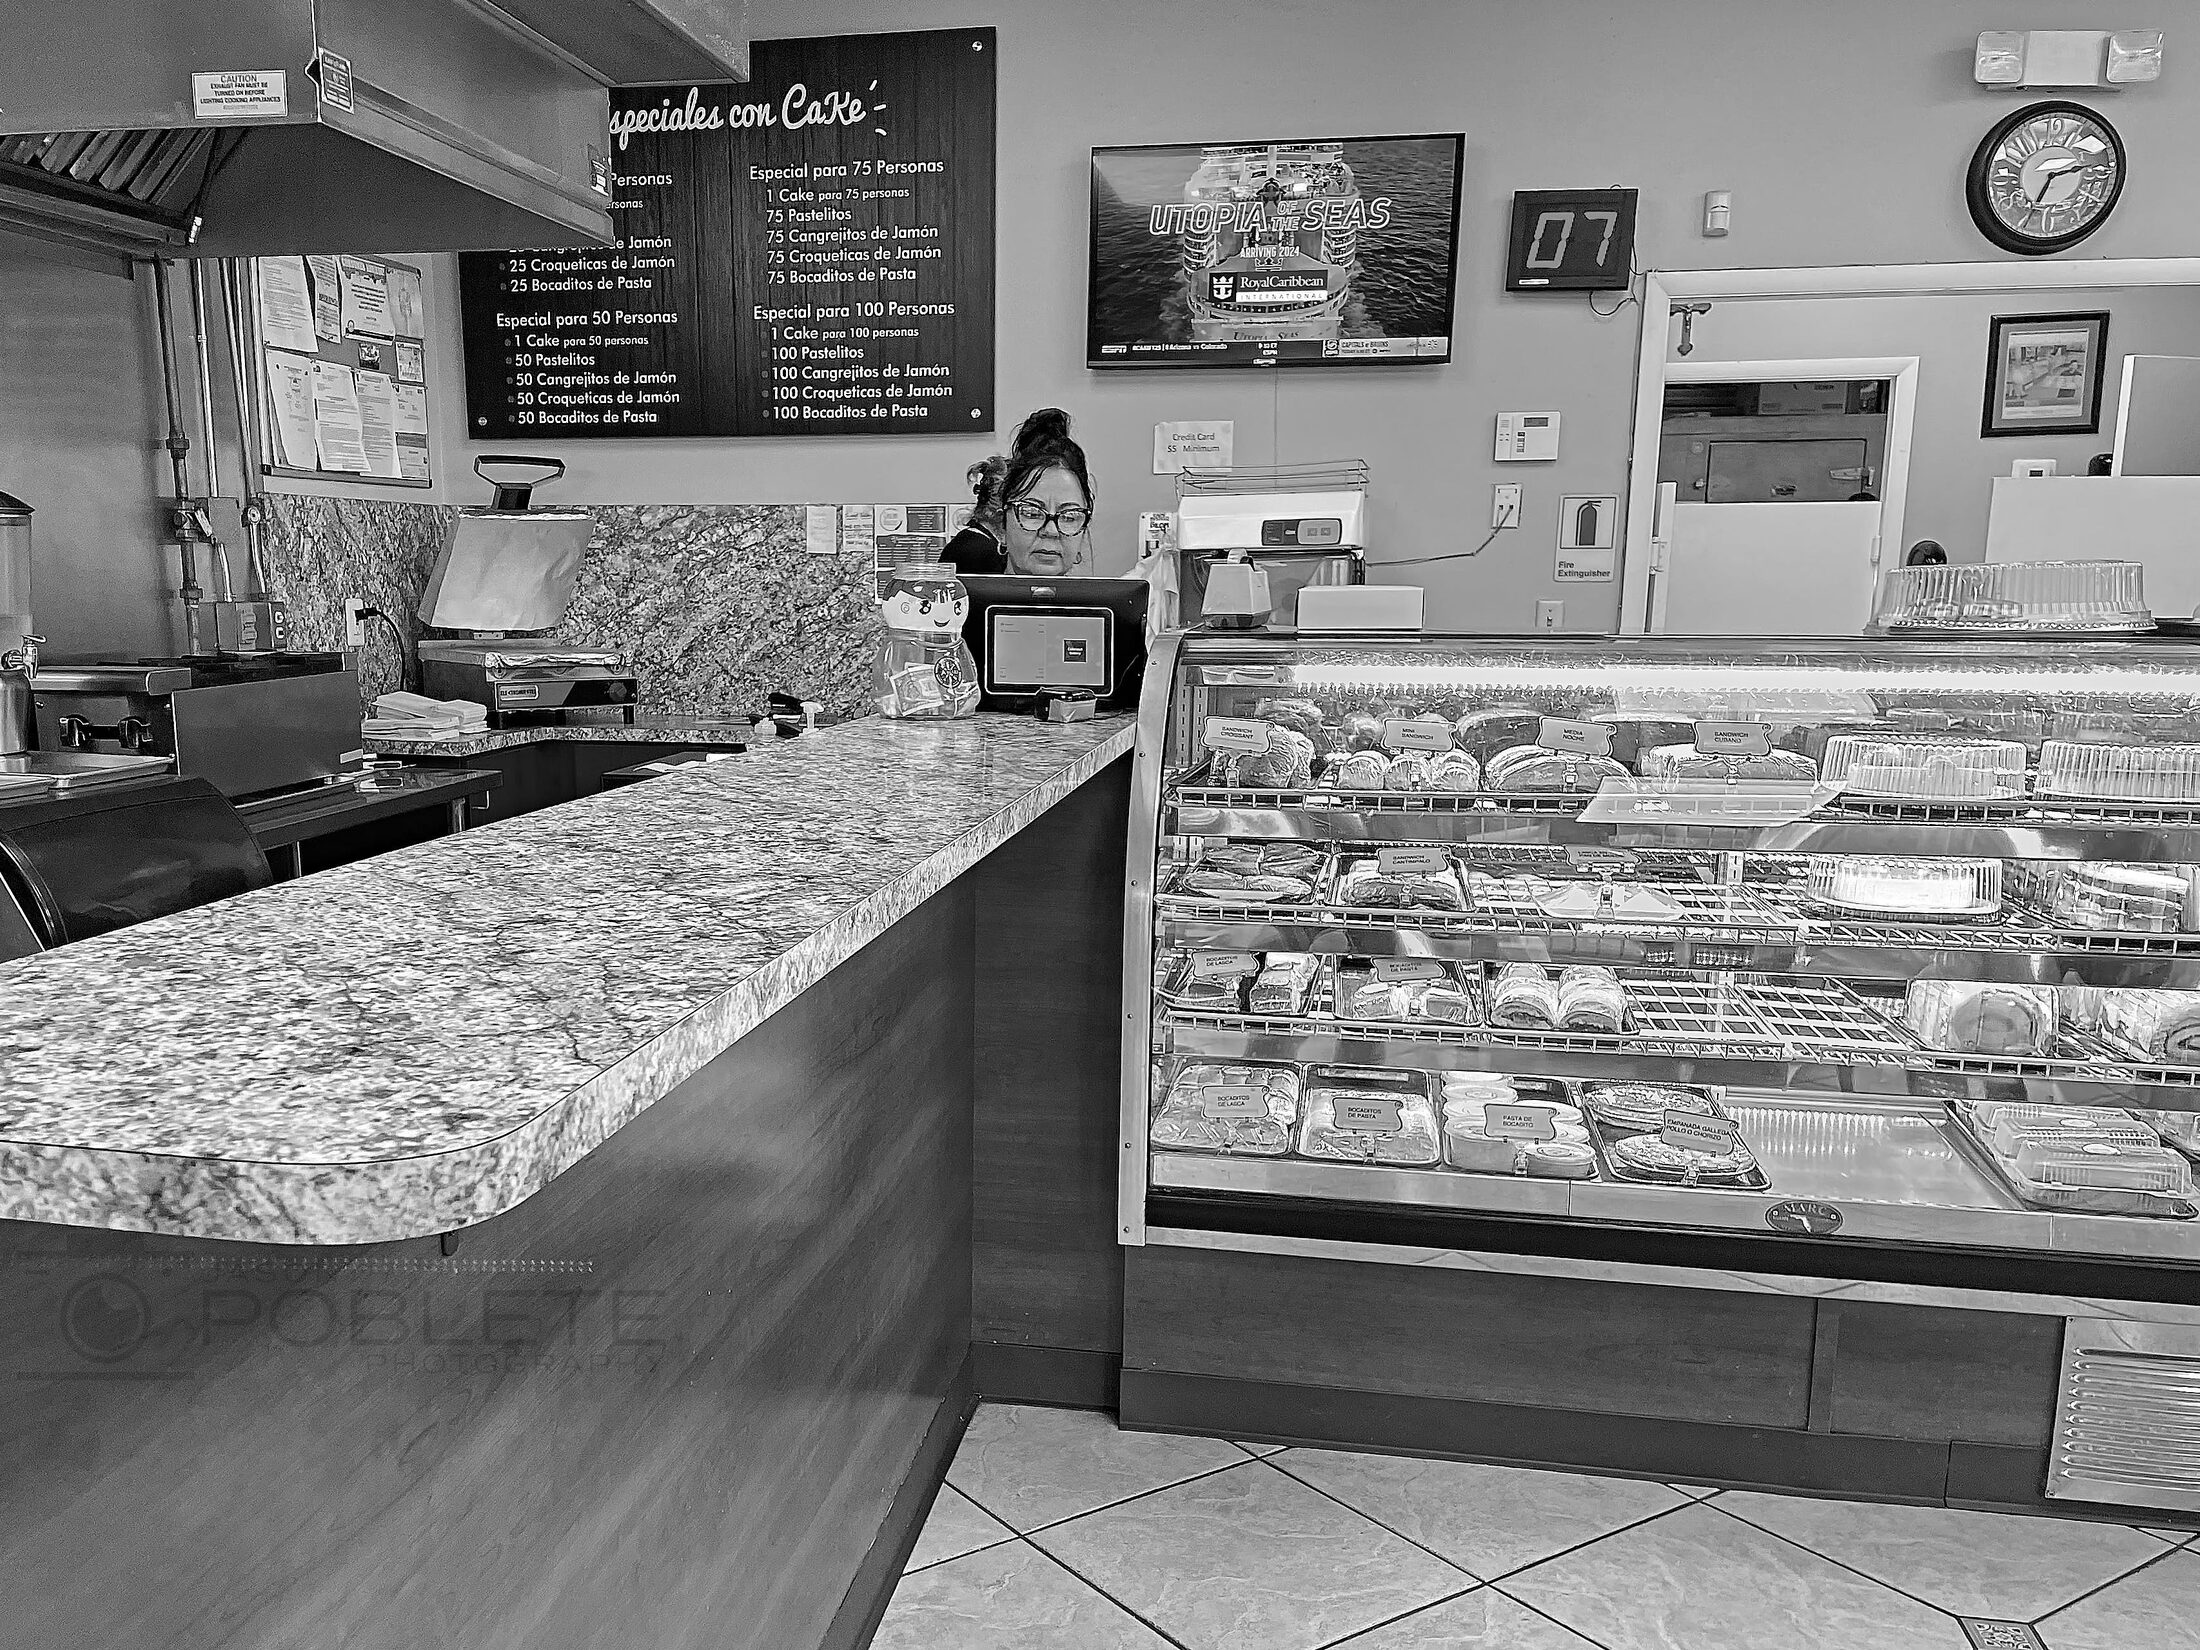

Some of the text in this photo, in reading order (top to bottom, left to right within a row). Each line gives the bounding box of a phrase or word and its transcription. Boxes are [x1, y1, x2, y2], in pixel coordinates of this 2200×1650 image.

[610, 87, 722, 150] speciales
[730, 101, 777, 128] con
[751, 160, 943, 182] Especial para 75 Personas
[611, 173, 672, 186] Personas
[767, 188, 909, 202] 1 Cake para 75 personas
[606, 200, 643, 208] rsonas
[767, 207, 851, 222] 75 Pastelitos
[1150, 197, 1392, 235] UTOPIA OF THE SEAS
[629, 235, 671, 248] Jamón
[767, 225, 937, 244] 75 Cangrejitos de Jamón
[1526, 211, 1618, 269] 07
[768, 246, 941, 267] 75 Croqueticas de Jamón
[1240, 246, 1300, 258] ARRIVING 2024
[510, 256, 674, 273] 25 Croqueticas de Jamón
[768, 267, 915, 284] 75 Bocaditos de Pasta
[511, 277, 651, 291] 25 Bocaditos de Pasta
[1240, 276, 1324, 291] RoyalCaribbean
[754, 302, 954, 322] Especial para 100 Personas
[497, 311, 677, 329] Especial para 50 Personas
[515, 334, 648, 348] 1 Cake para 50 personas
[772, 326, 919, 341] 1 Cake para 100 personas
[516, 353, 594, 366] 50 Pastelitos
[773, 345, 863, 359] 100 Pastelitos
[517, 371, 676, 388] 50 Cangrejitos de Jamón
[773, 364, 949, 381] 100 Cangrejitos de Jamón
[518, 391, 679, 407] 50 Croqueticas de Jamón
[773, 384, 952, 401] 100 Croqueticas de Jamón
[518, 410, 656, 424] 50 Bocaditos de Pasta
[774, 404, 927, 418] 100 Bocaditos de Pasta
[1558, 570, 1610, 578] Extinguisher
[1668, 1119, 1700, 1129] EMPANADA
[1667, 1125, 1686, 1133] POLLO
[1693, 1131, 1721, 1140] CHORIZO
